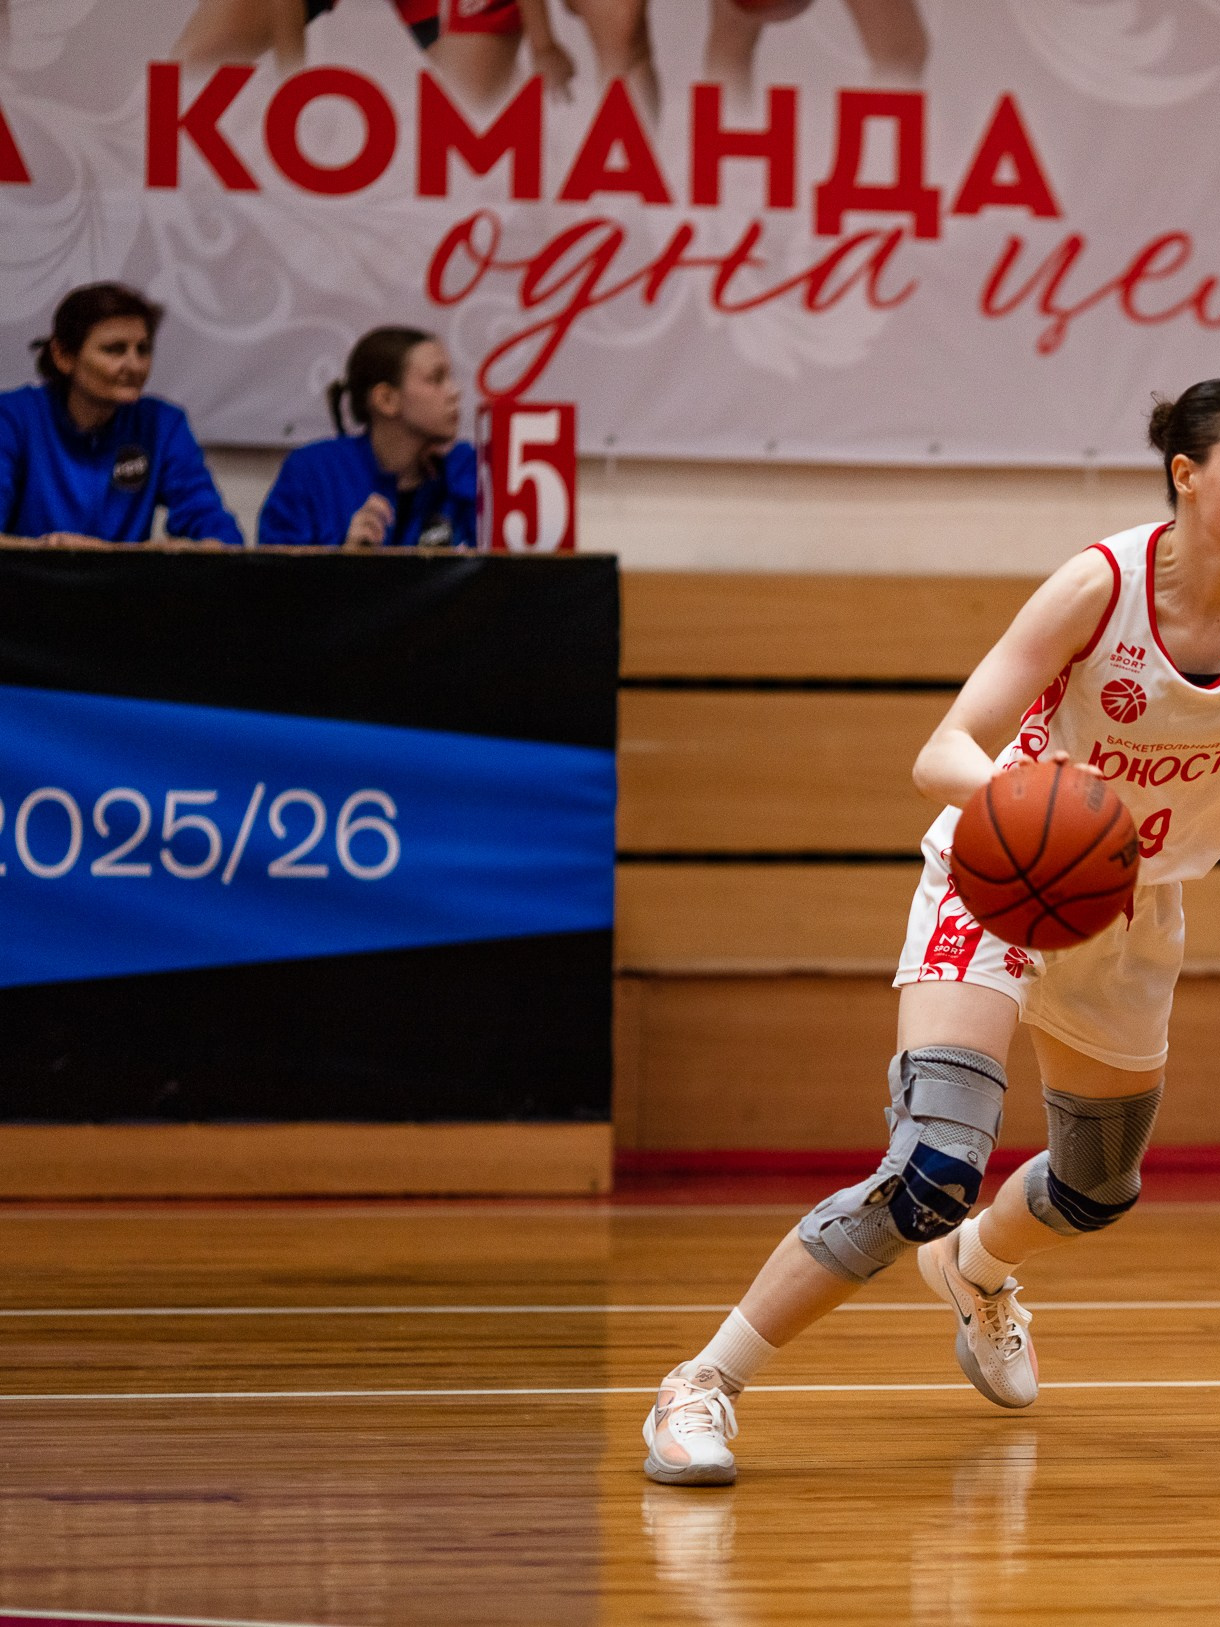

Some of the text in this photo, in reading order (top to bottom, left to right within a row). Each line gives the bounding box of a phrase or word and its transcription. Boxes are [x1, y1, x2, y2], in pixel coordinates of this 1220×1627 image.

[146, 62, 1063, 240] КОМАНДА
[426, 208, 920, 402] одна
[502, 409, 571, 554] 5
[1110, 653, 1146, 670] SPORT
[1106, 735, 1220, 753] БАСКЕТБОЛЬНЫЙ
[0, 782, 401, 885] 025/26
[1139, 808, 1172, 858] 9
[933, 945, 965, 956] SPORT
